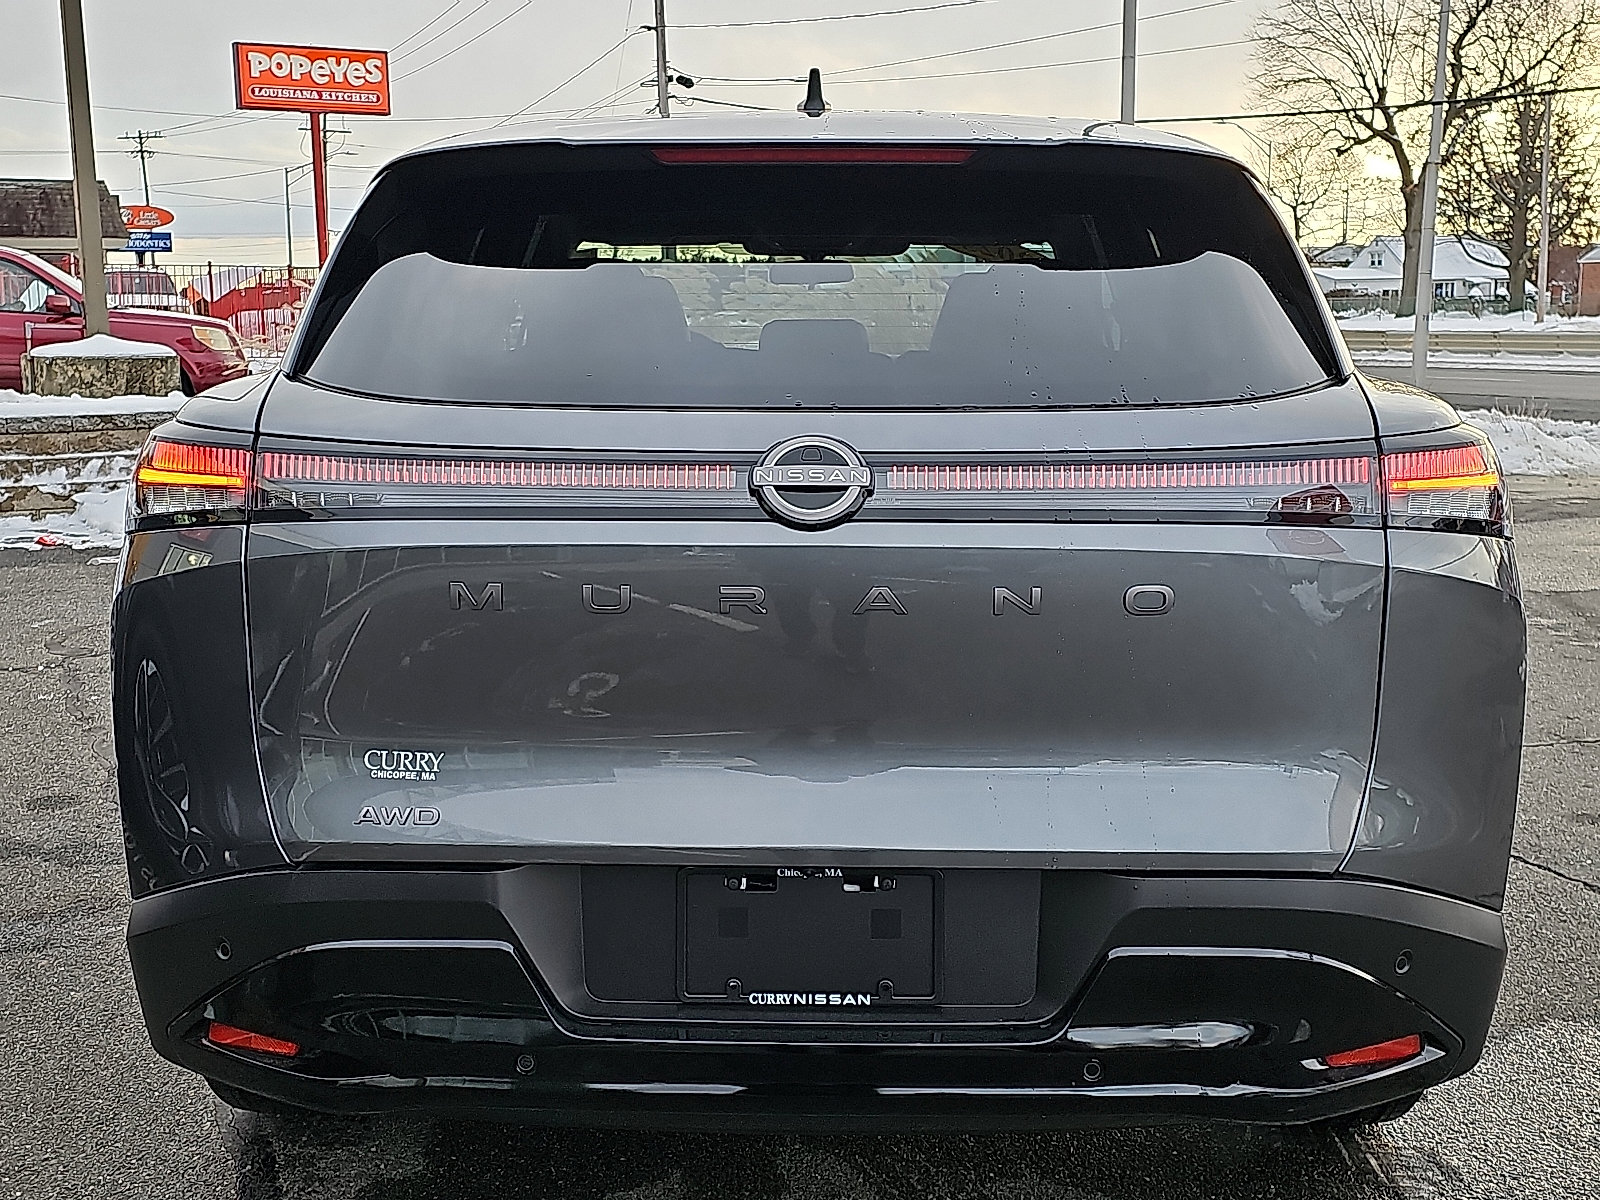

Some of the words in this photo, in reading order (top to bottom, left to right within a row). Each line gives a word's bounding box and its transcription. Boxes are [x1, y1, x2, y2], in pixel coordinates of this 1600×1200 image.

[253, 87, 320, 100] LOUISIANA
[321, 91, 378, 102] KITCHEN
[756, 469, 867, 483] NISSAN
[449, 581, 1176, 617] MURANO
[363, 749, 445, 772] CURRY
[370, 769, 420, 781] CHICOPEE,
[421, 772, 436, 781] MA
[352, 805, 441, 827] AWD
[824, 868, 843, 877] MA
